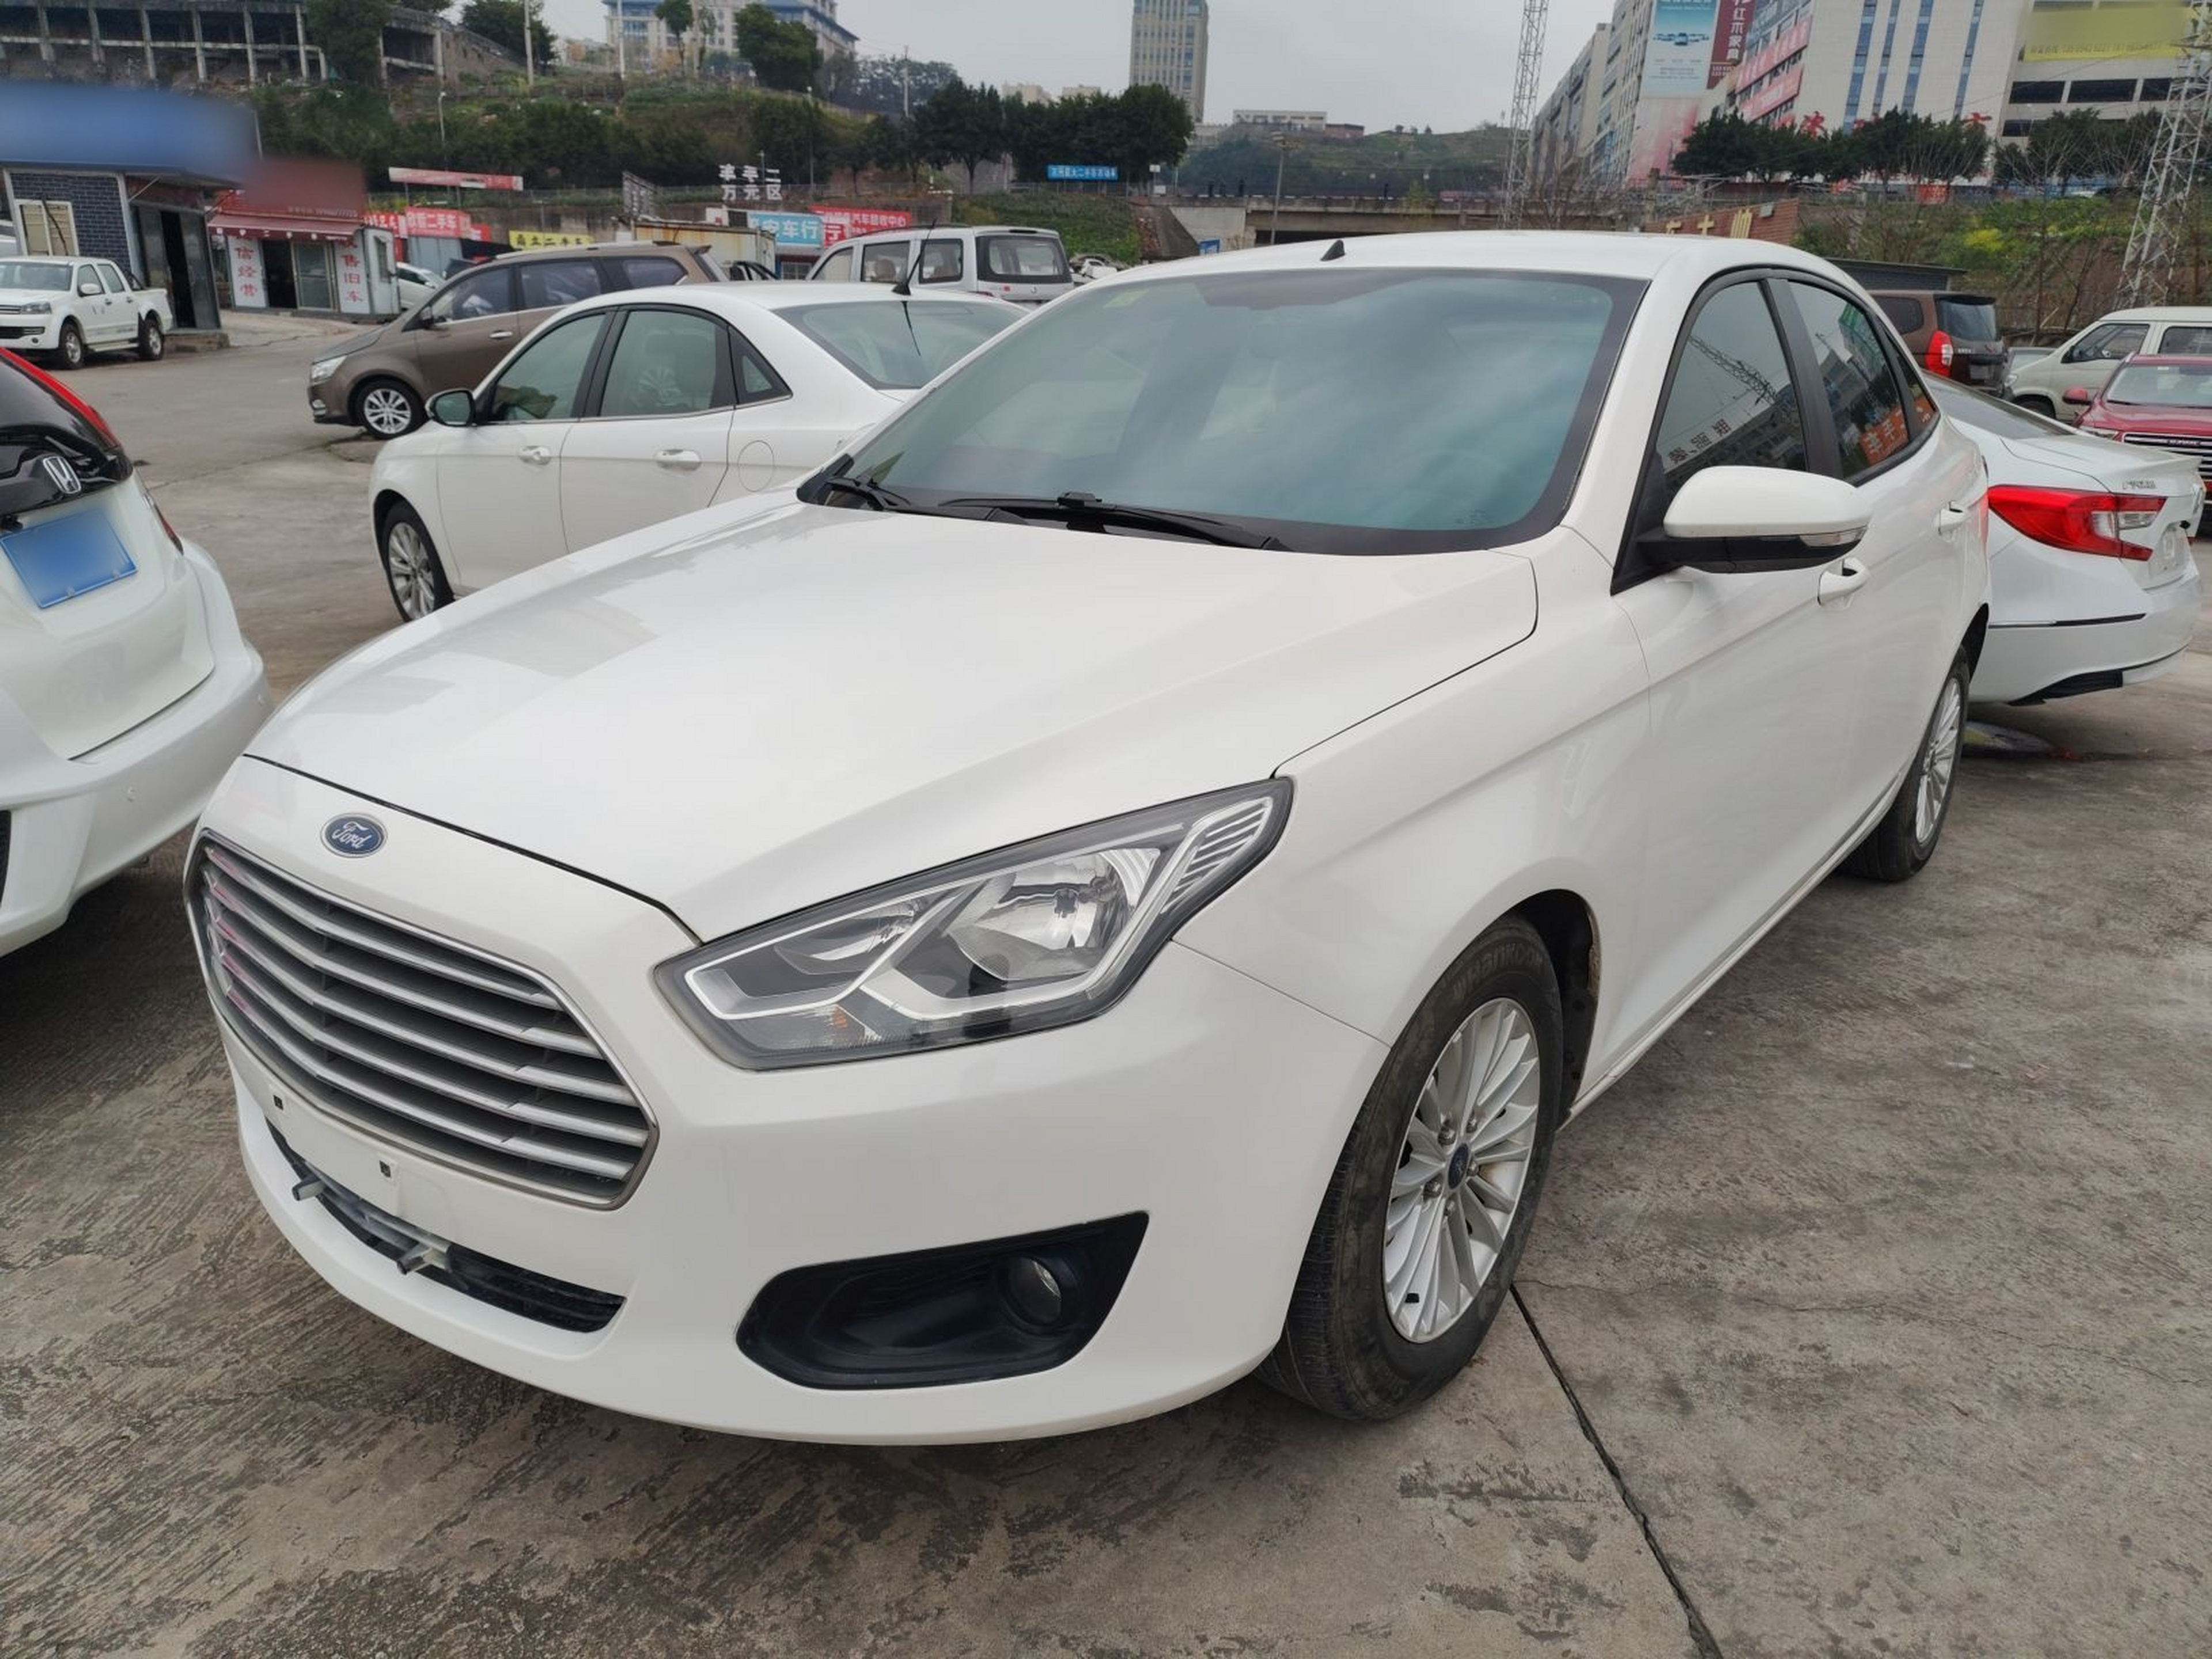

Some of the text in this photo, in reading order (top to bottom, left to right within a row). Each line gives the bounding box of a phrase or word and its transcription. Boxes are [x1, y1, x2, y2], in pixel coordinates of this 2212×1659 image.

[1726, 0, 1751, 60] 红木家具
[721, 184, 782, 200] 万元区
[332, 821, 372, 849] Ford
